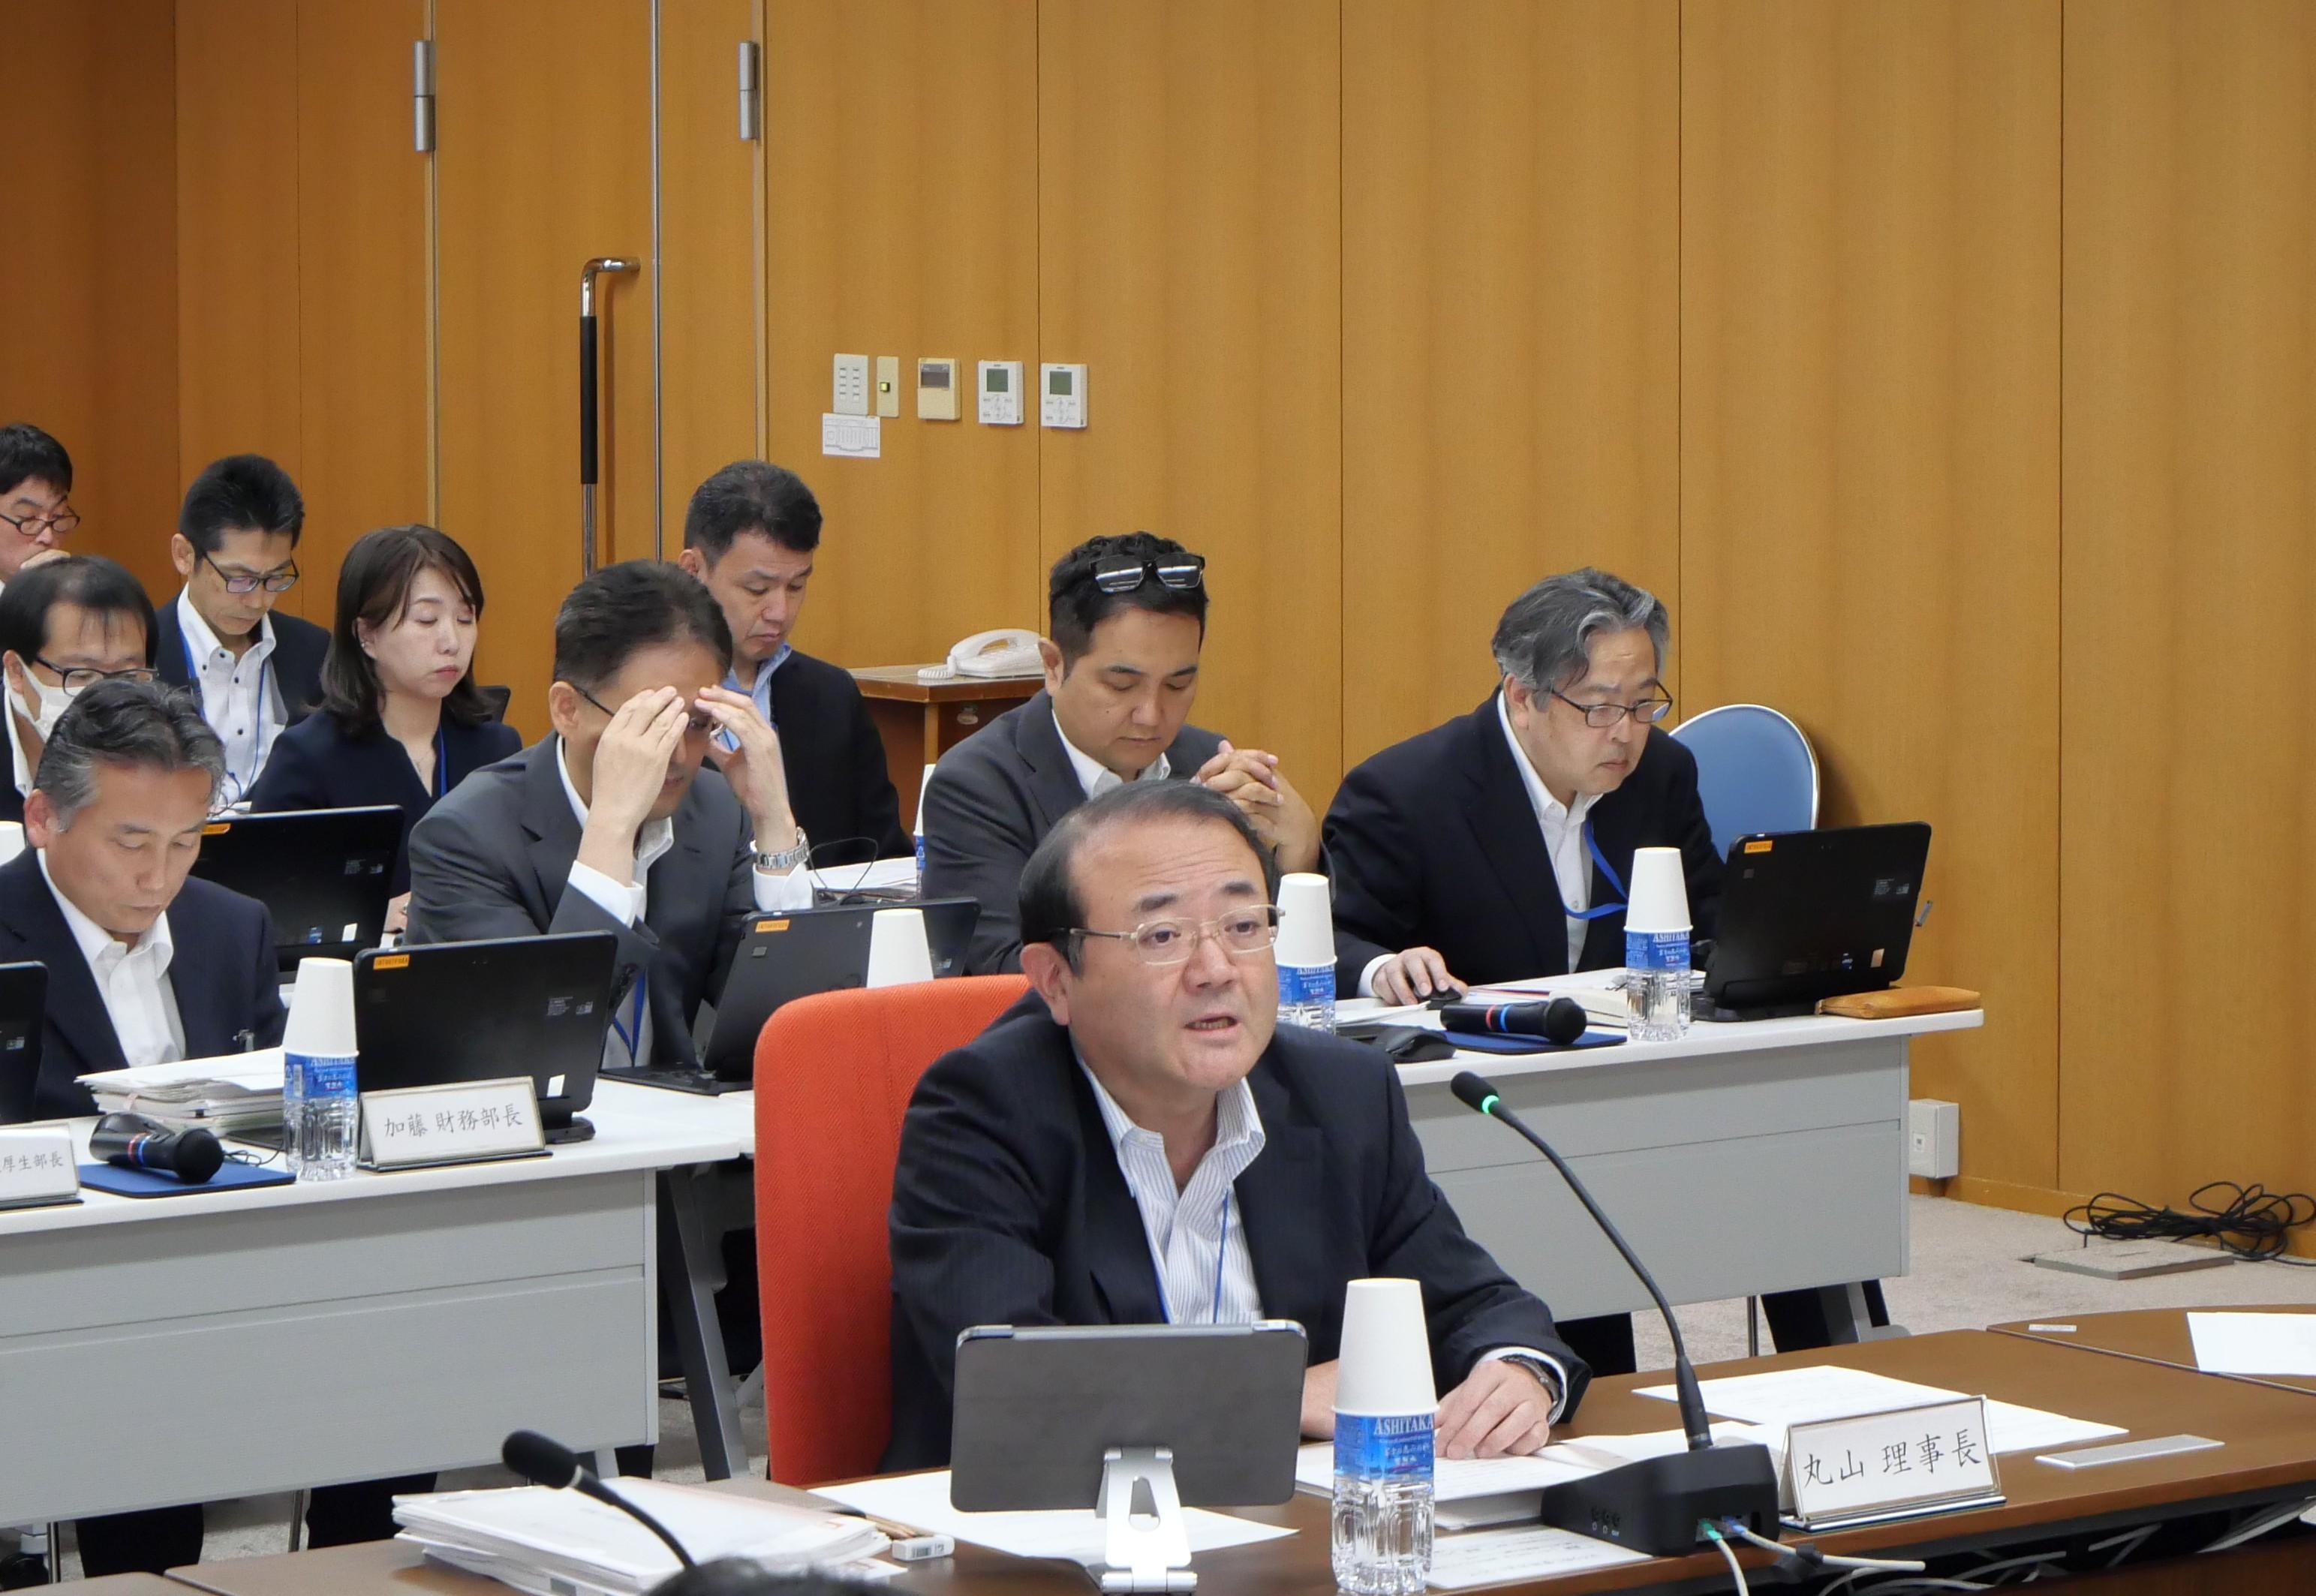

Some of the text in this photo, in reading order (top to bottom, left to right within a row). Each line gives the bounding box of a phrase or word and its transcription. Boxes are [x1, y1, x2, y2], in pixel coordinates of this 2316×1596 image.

[384, 1104, 522, 1137] 加藤 財務部長
[0, 1150, 64, 1173] 厚生部長
[1373, 1414, 1433, 1435] ASHITAKA
[1803, 1429, 1981, 1488] 丸山 理事長
